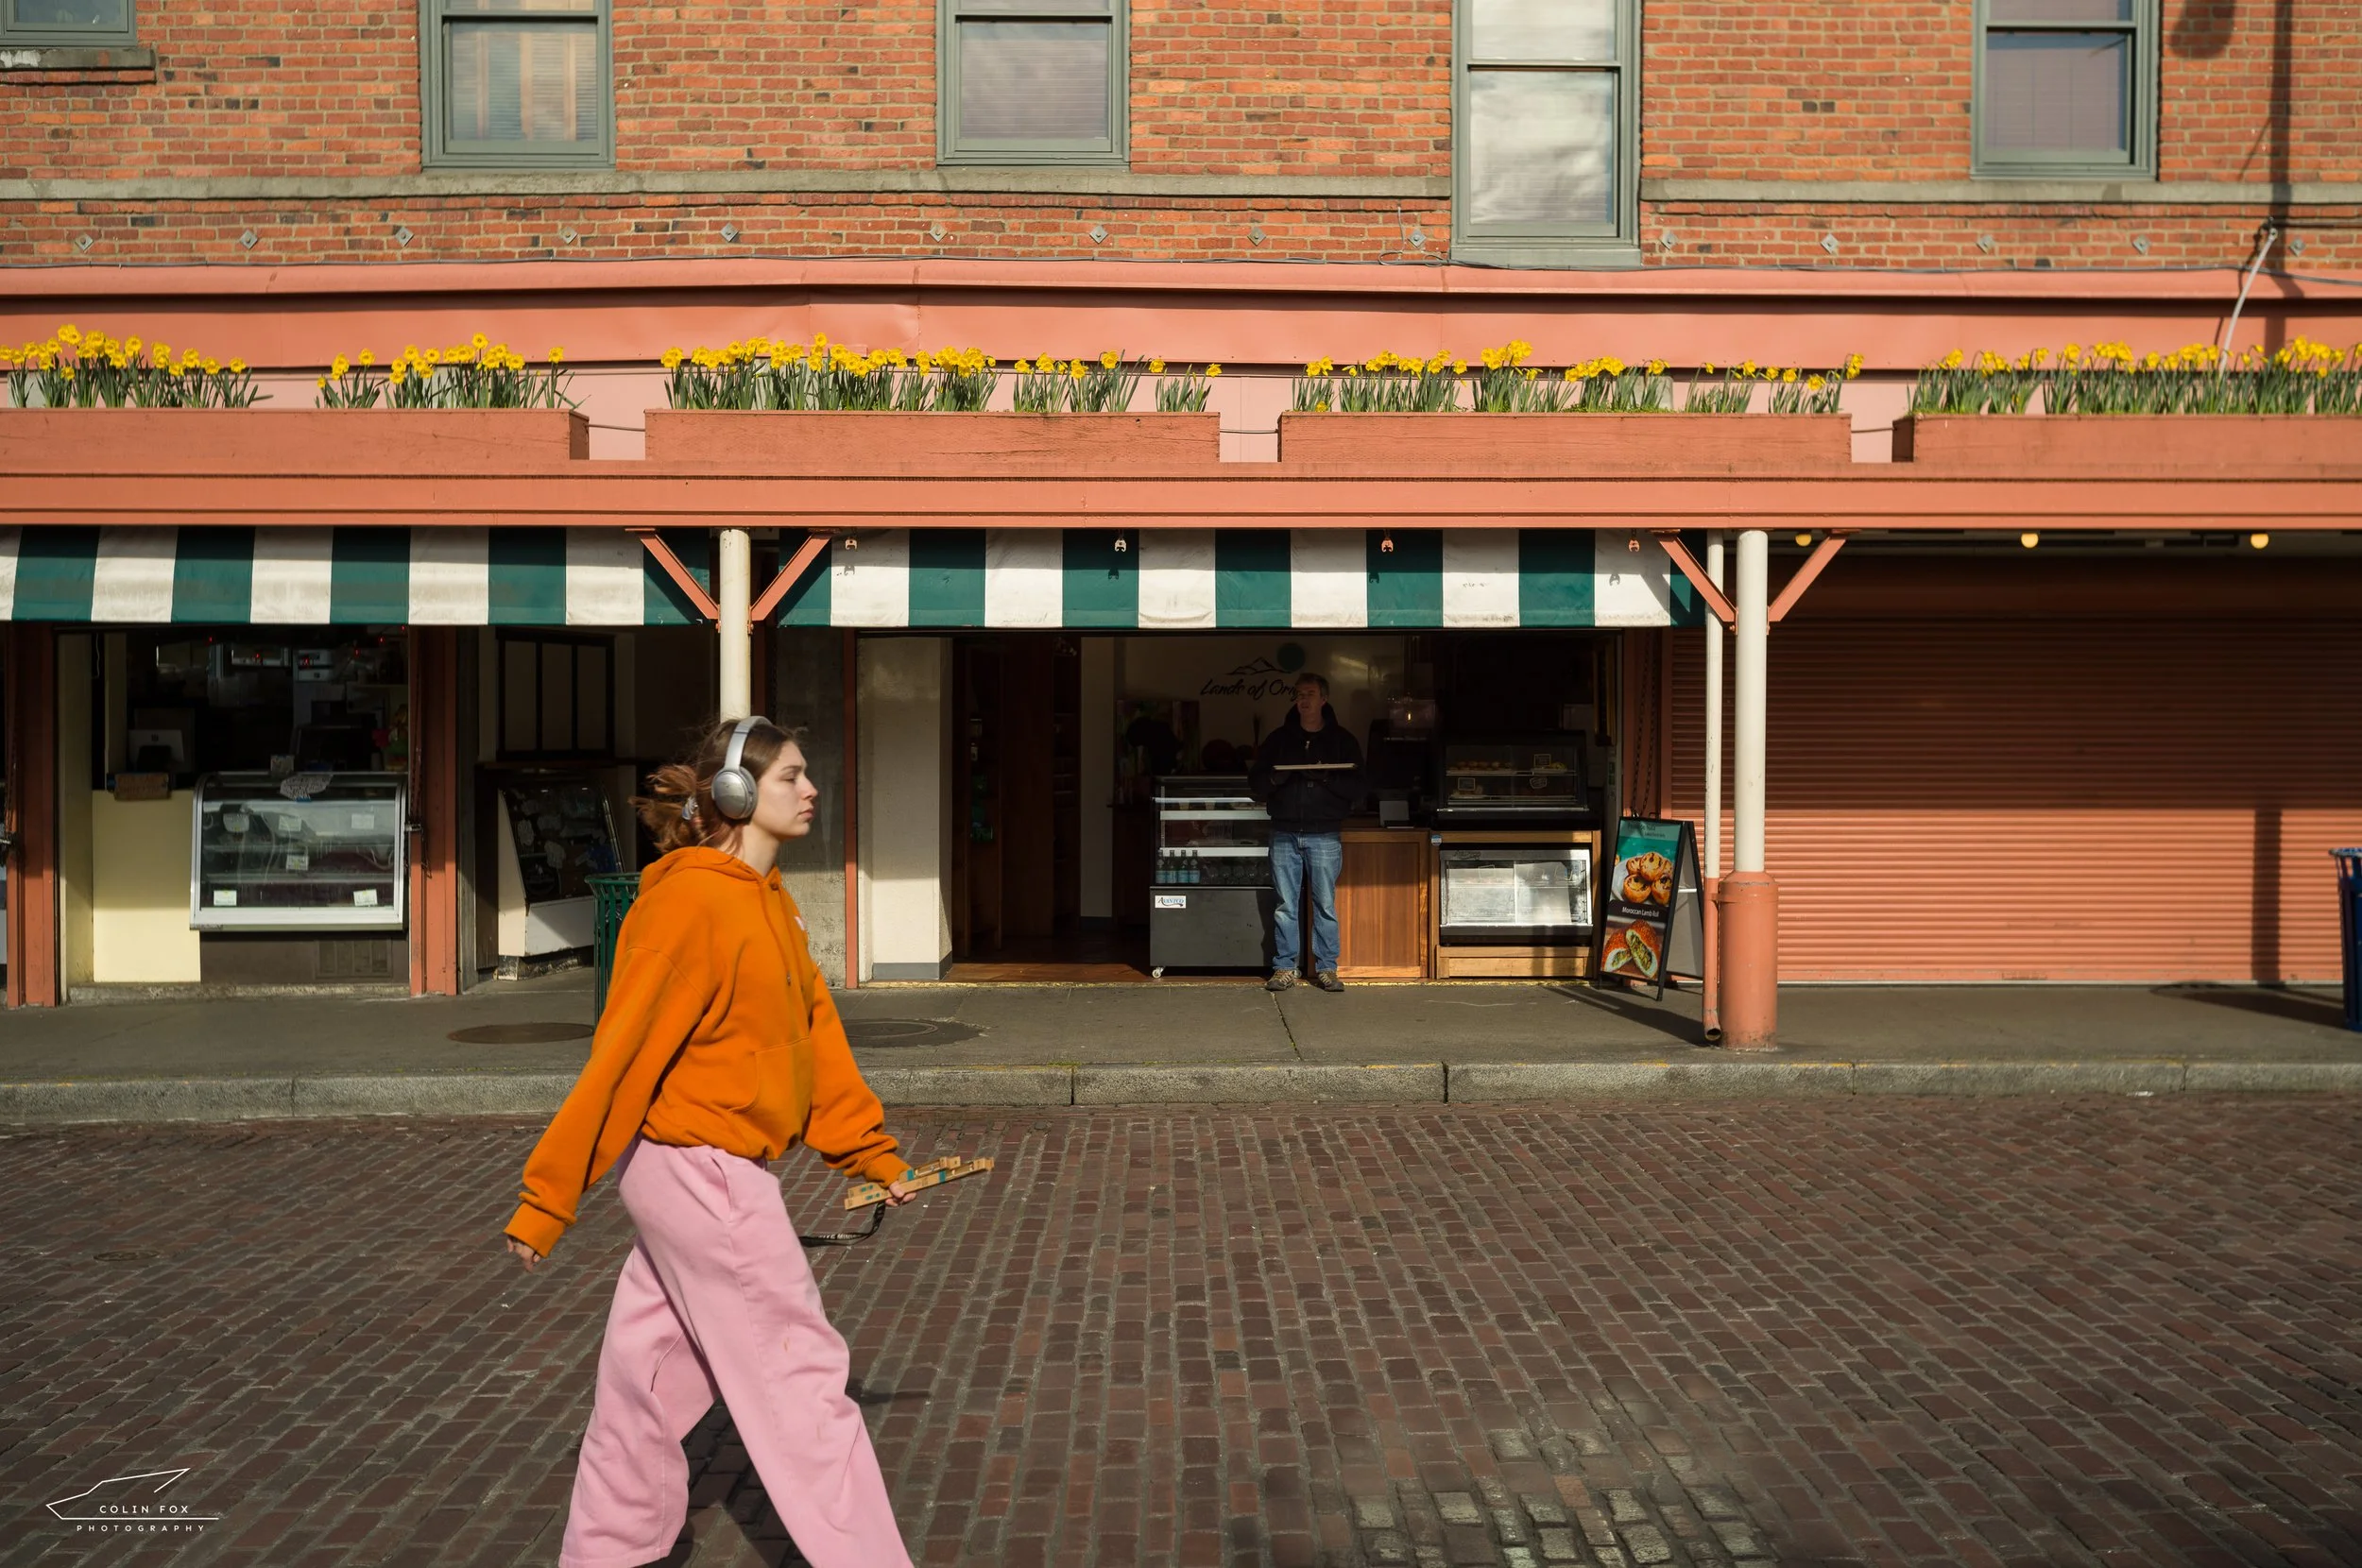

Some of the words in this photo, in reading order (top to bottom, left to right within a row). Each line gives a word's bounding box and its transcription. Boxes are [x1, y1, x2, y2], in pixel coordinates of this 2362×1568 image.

[1201, 678, 1244, 695] Lands
[1247, 679, 1268, 701] of
[1621, 906, 1641, 915] Moroccan
